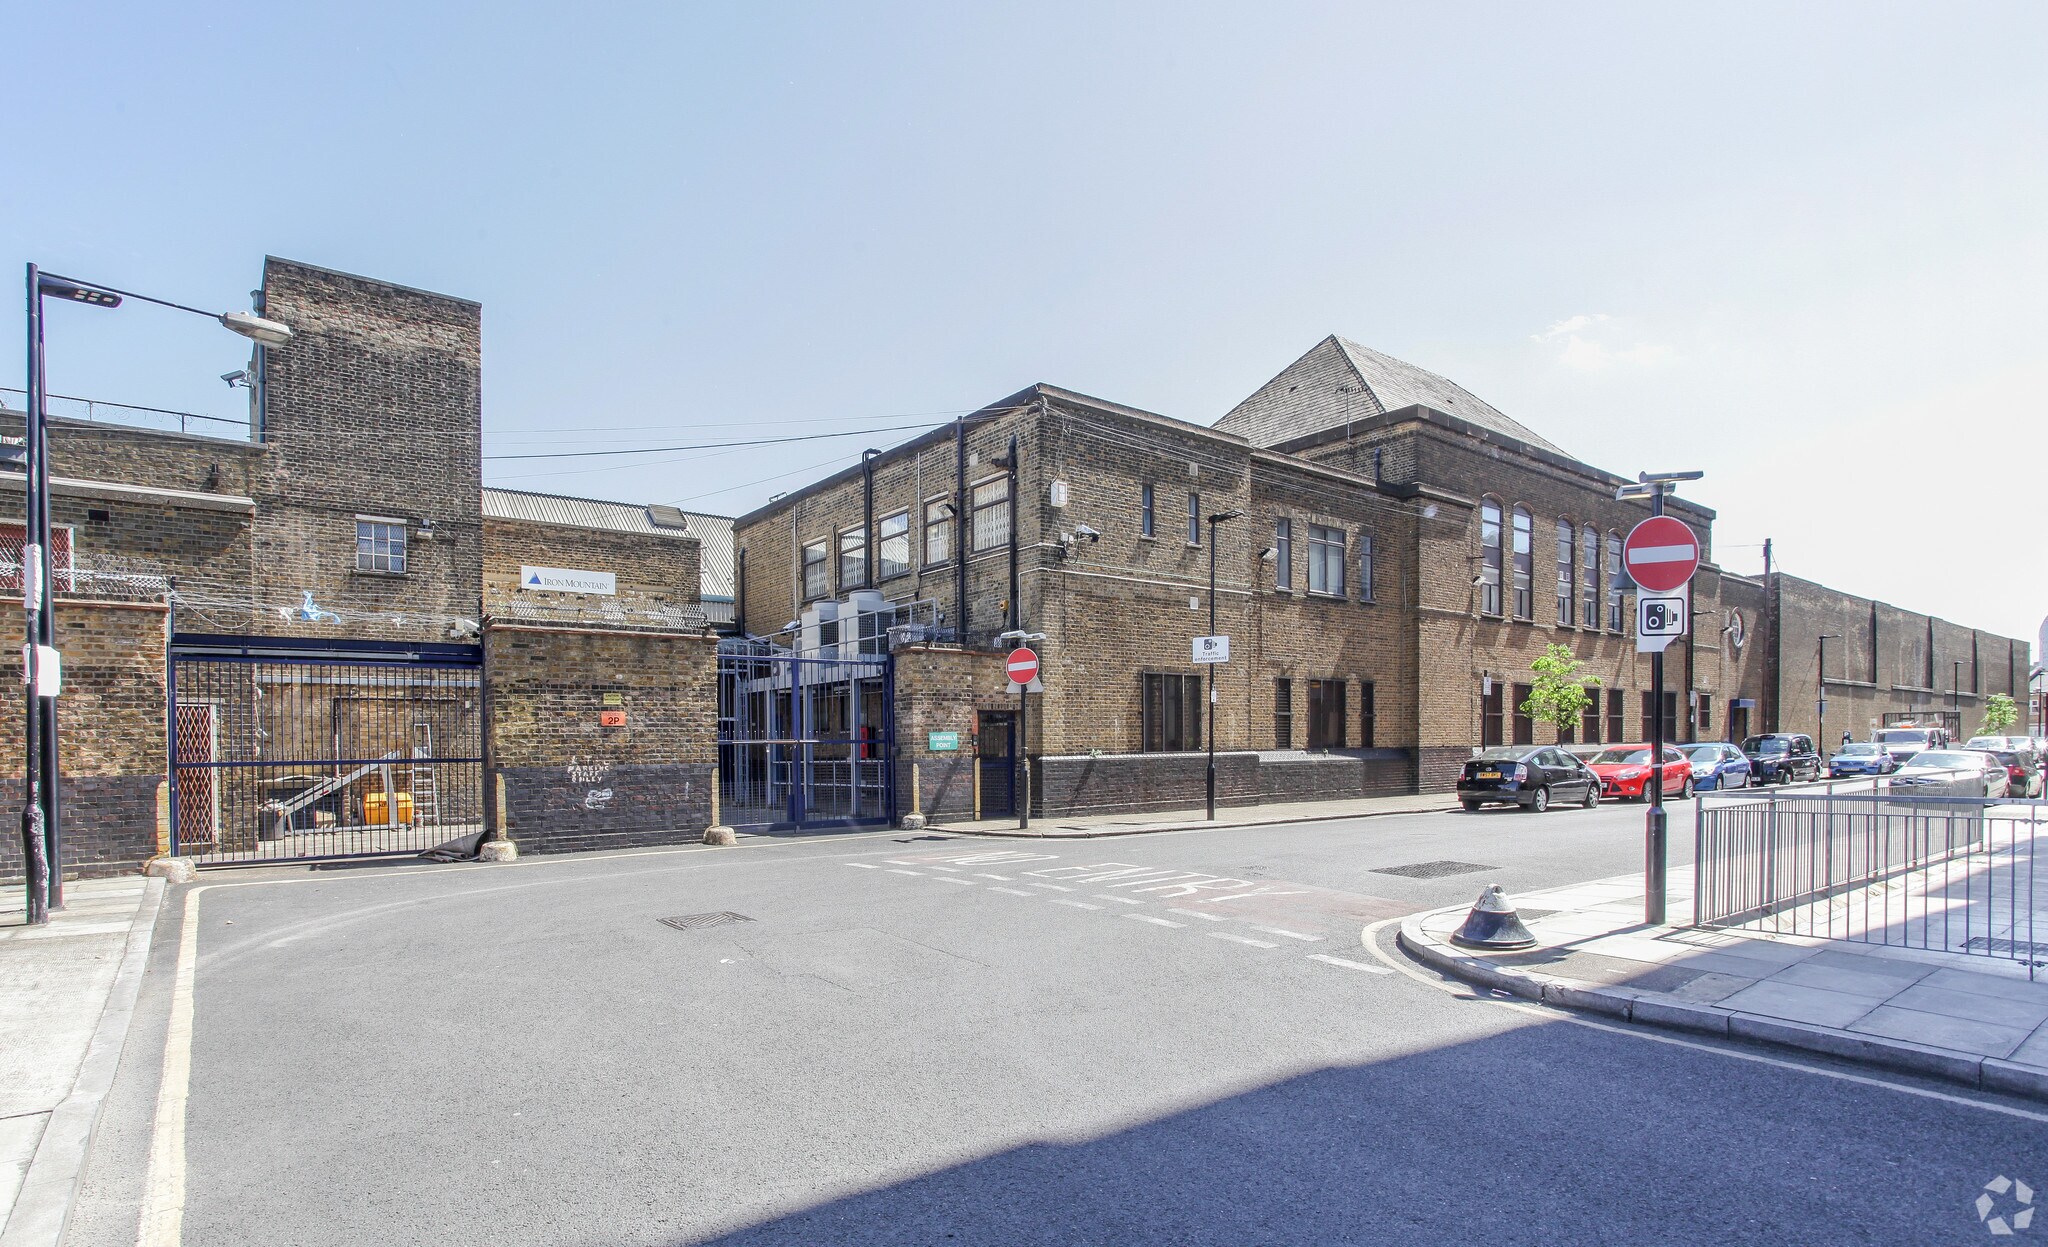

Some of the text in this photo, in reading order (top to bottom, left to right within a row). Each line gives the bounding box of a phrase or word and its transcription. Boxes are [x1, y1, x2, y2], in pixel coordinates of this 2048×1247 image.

[544, 577, 608, 590] IRON MOUNTAIN
[607, 717, 620, 725] 2P
[1021, 862, 1310, 903] ENTRY
